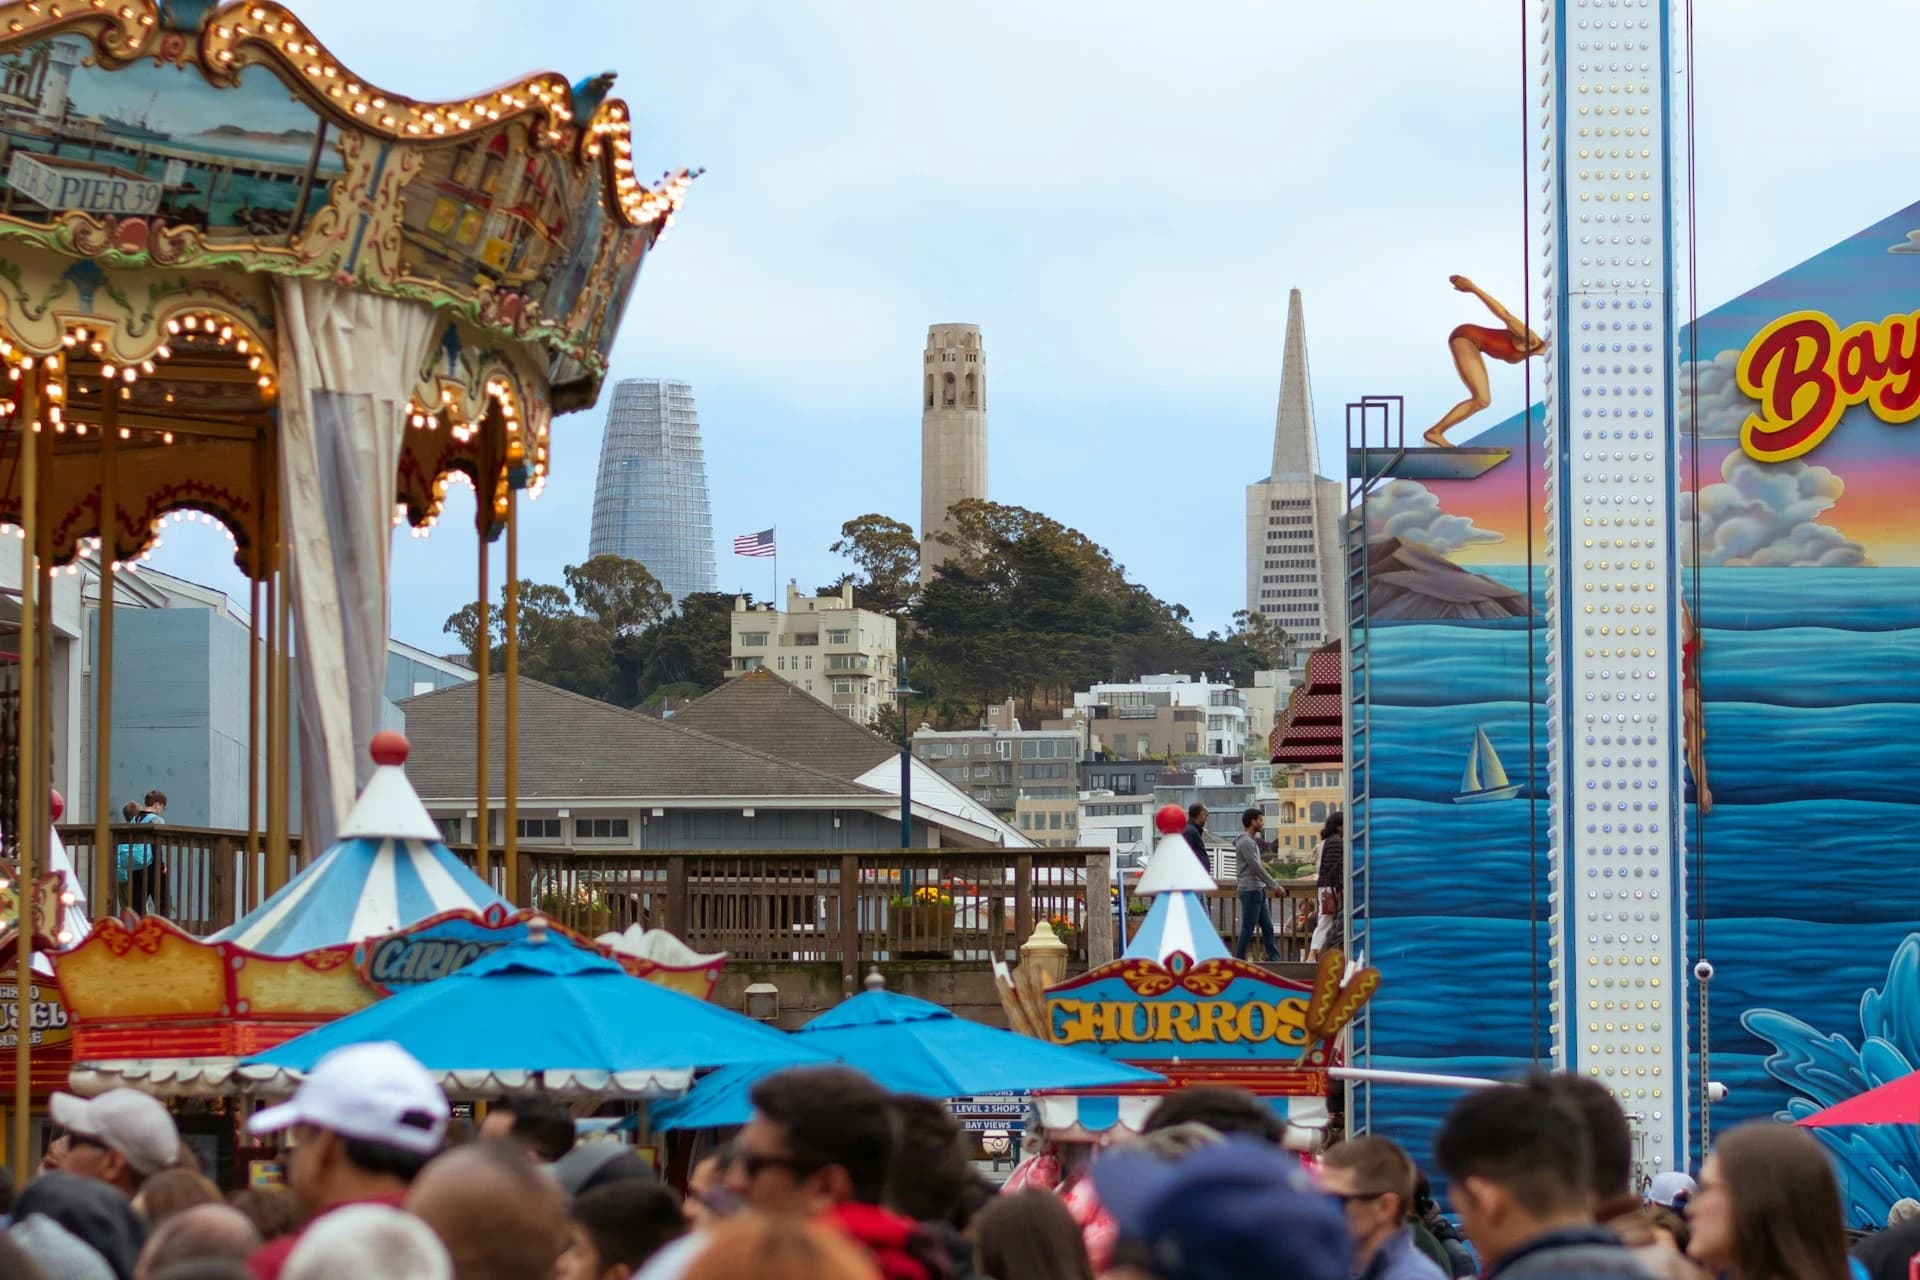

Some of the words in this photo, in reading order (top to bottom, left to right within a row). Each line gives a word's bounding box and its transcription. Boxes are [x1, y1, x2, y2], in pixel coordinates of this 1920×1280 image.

[57, 176, 128, 210] PIER
[131, 183, 160, 211] 39
[1050, 997, 1311, 1045] CHURROS
[956, 1105, 981, 1113] LEVEL
[991, 1105, 1021, 1113] SHOPS
[965, 1121, 982, 1129] BAY
[983, 1121, 1011, 1129] VIEWS
